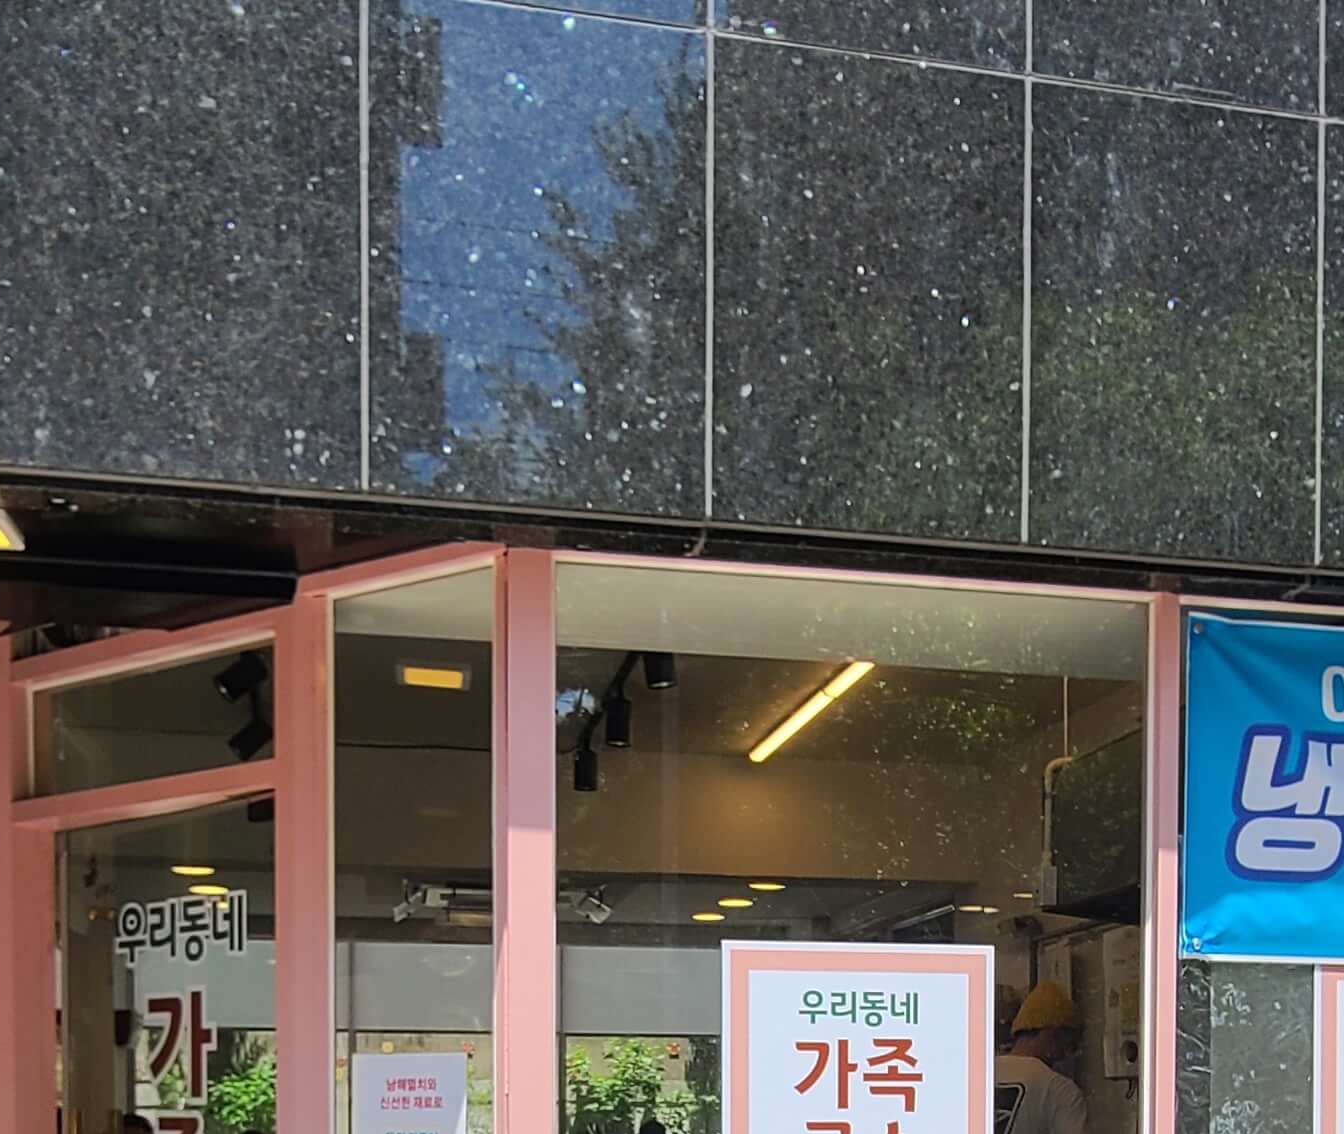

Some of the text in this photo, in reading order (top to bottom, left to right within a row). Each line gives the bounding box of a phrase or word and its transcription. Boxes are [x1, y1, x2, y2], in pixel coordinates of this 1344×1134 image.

[115, 890, 248, 961] 우리동네
[799, 989, 919, 1027] 우리동네
[381, 1096, 443, 1110] 신선한 재료로
[794, 1039, 923, 1113] 가족
